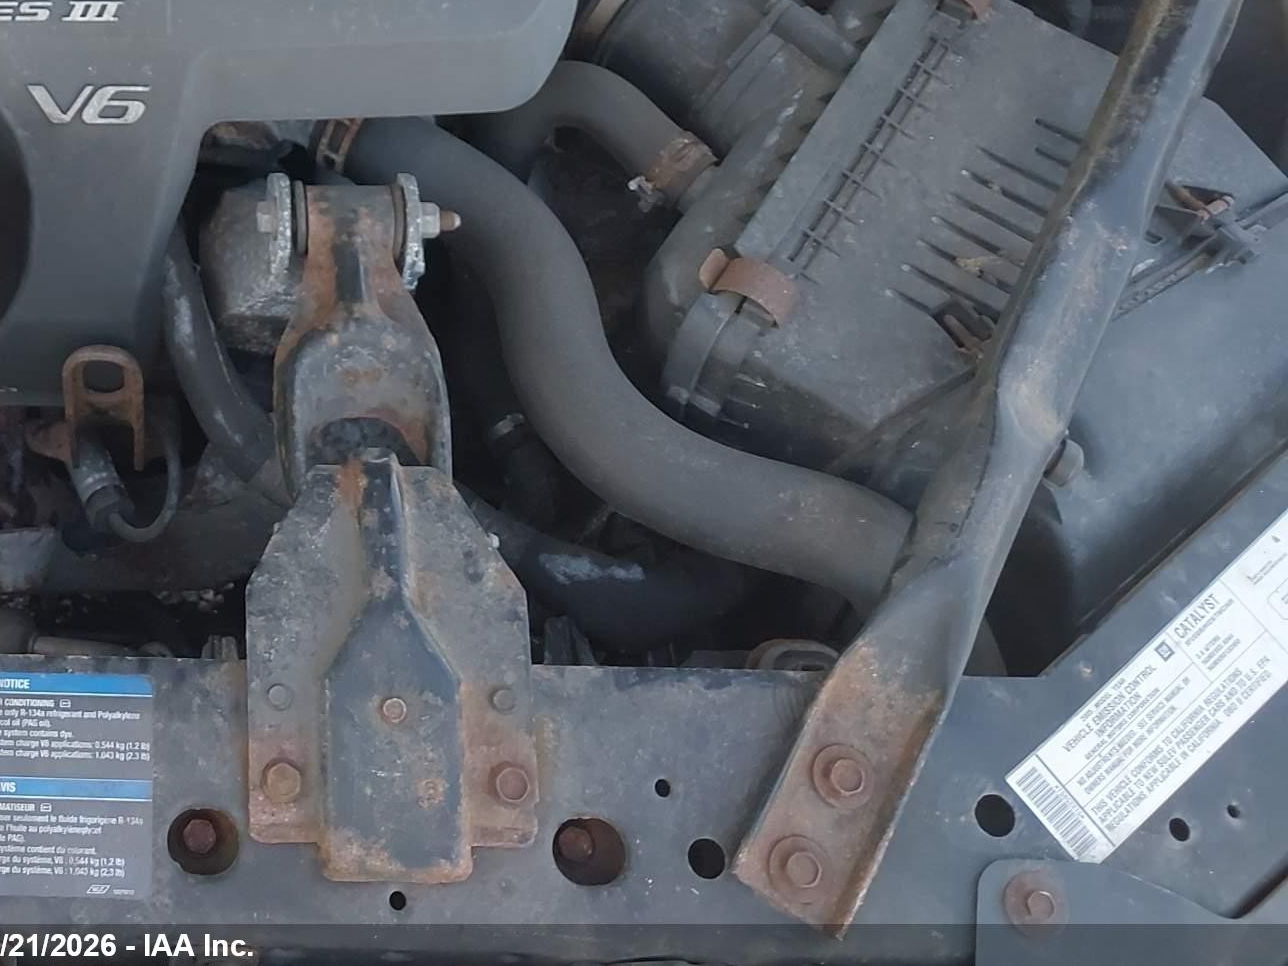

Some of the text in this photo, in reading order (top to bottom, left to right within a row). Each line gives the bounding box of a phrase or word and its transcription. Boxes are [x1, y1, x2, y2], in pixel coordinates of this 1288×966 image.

[61, 0, 125, 22] III
[26, 84, 152, 124] V6
[1174, 593, 1219, 638] CATALYST
[4, 698, 54, 707] CONDITIONING
[1062, 665, 1156, 751] VEHICLE EMISSION CONTROL
[1094, 692, 1141, 737] INFORMATION
[1090, 798, 1107, 815] THIS
[1106, 775, 1132, 800] VEHICLE
[1130, 744, 1163, 777] CONFORMS
[1161, 736, 1172, 746] TO
[1170, 705, 1204, 738] CALIFORNIA
[1203, 667, 1242, 706] REGULATIONS
[1098, 787, 1135, 823] APPLICABLE
[1133, 778, 1144, 789] TO
[1142, 765, 1158, 780] NEW
[1175, 714, 1210, 748] PASSENGER
[1208, 699, 1225, 717] CARS
[1223, 686, 1238, 701] AND
[1235, 678, 1246, 689] TO
[1256, 655, 1270, 669] EPA
[1105, 791, 1147, 832] REGULATIONS
[1146, 758, 1181, 793] APPLICABLE
[1179, 750, 1189, 759] IN
